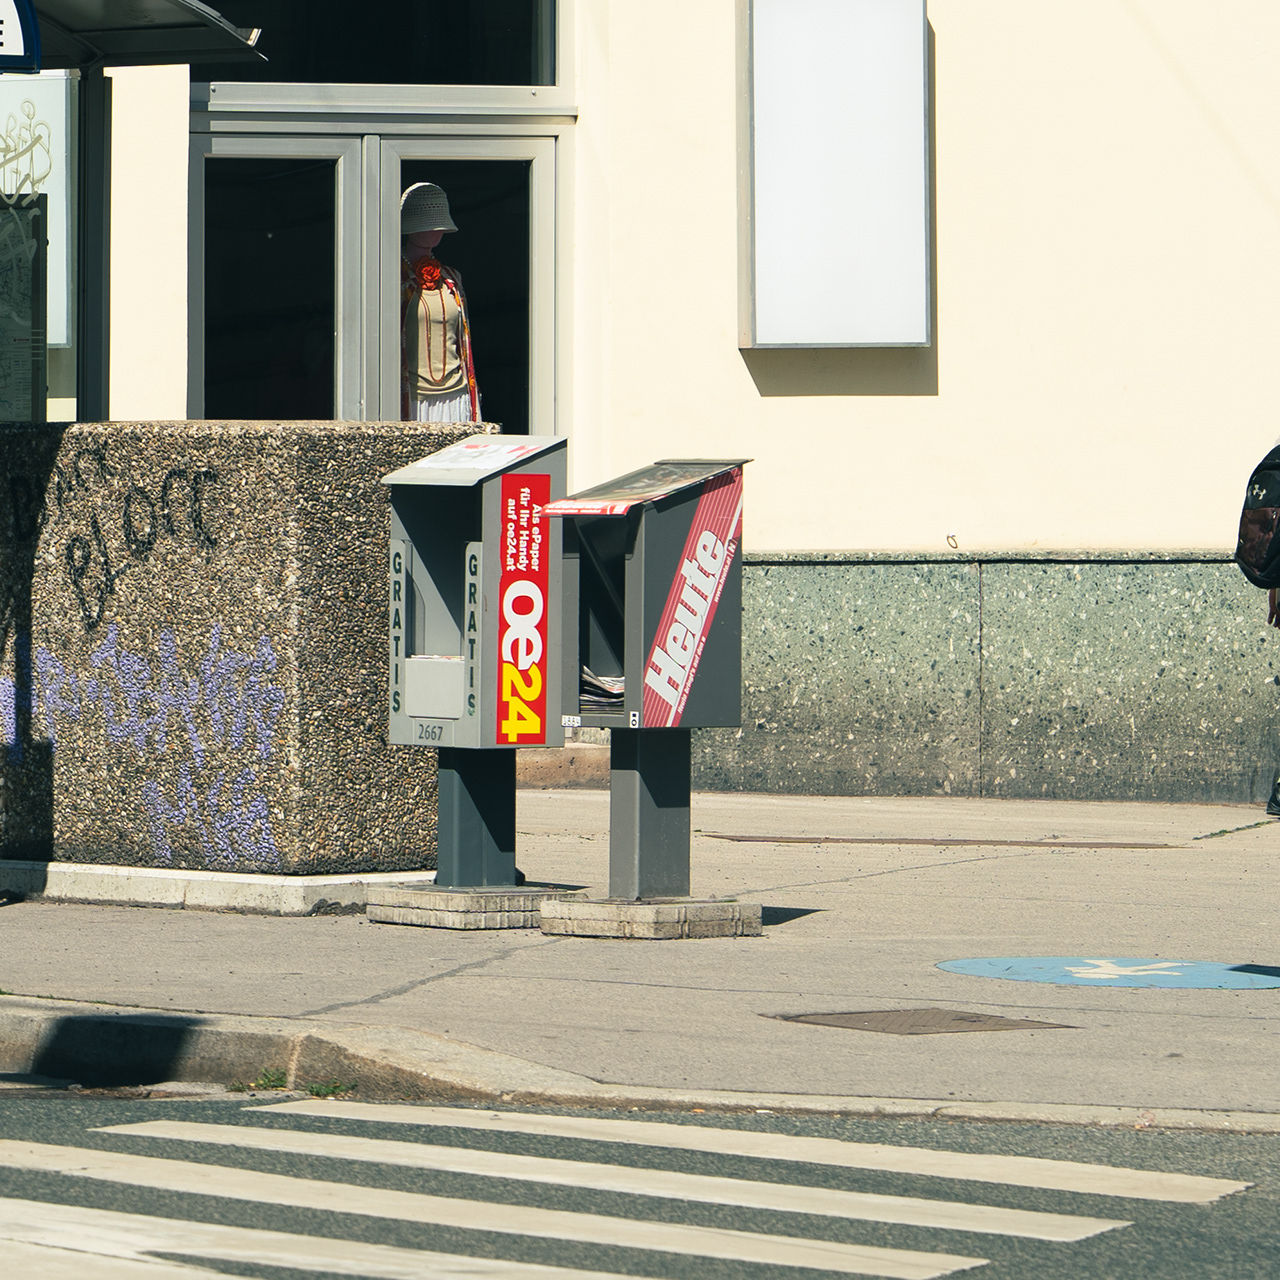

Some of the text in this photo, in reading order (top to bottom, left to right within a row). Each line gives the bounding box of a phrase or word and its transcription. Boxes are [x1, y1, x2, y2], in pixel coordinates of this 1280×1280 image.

[506, 498, 518, 572] auf oe24.at
[516, 486, 531, 572] für Ihr Handy
[529, 526, 542, 572] ePaper
[392, 551, 403, 714] GRATIS
[467, 553, 479, 717] GRATIS
[644, 530, 726, 708] Heute
[417, 723, 444, 742] 2667
